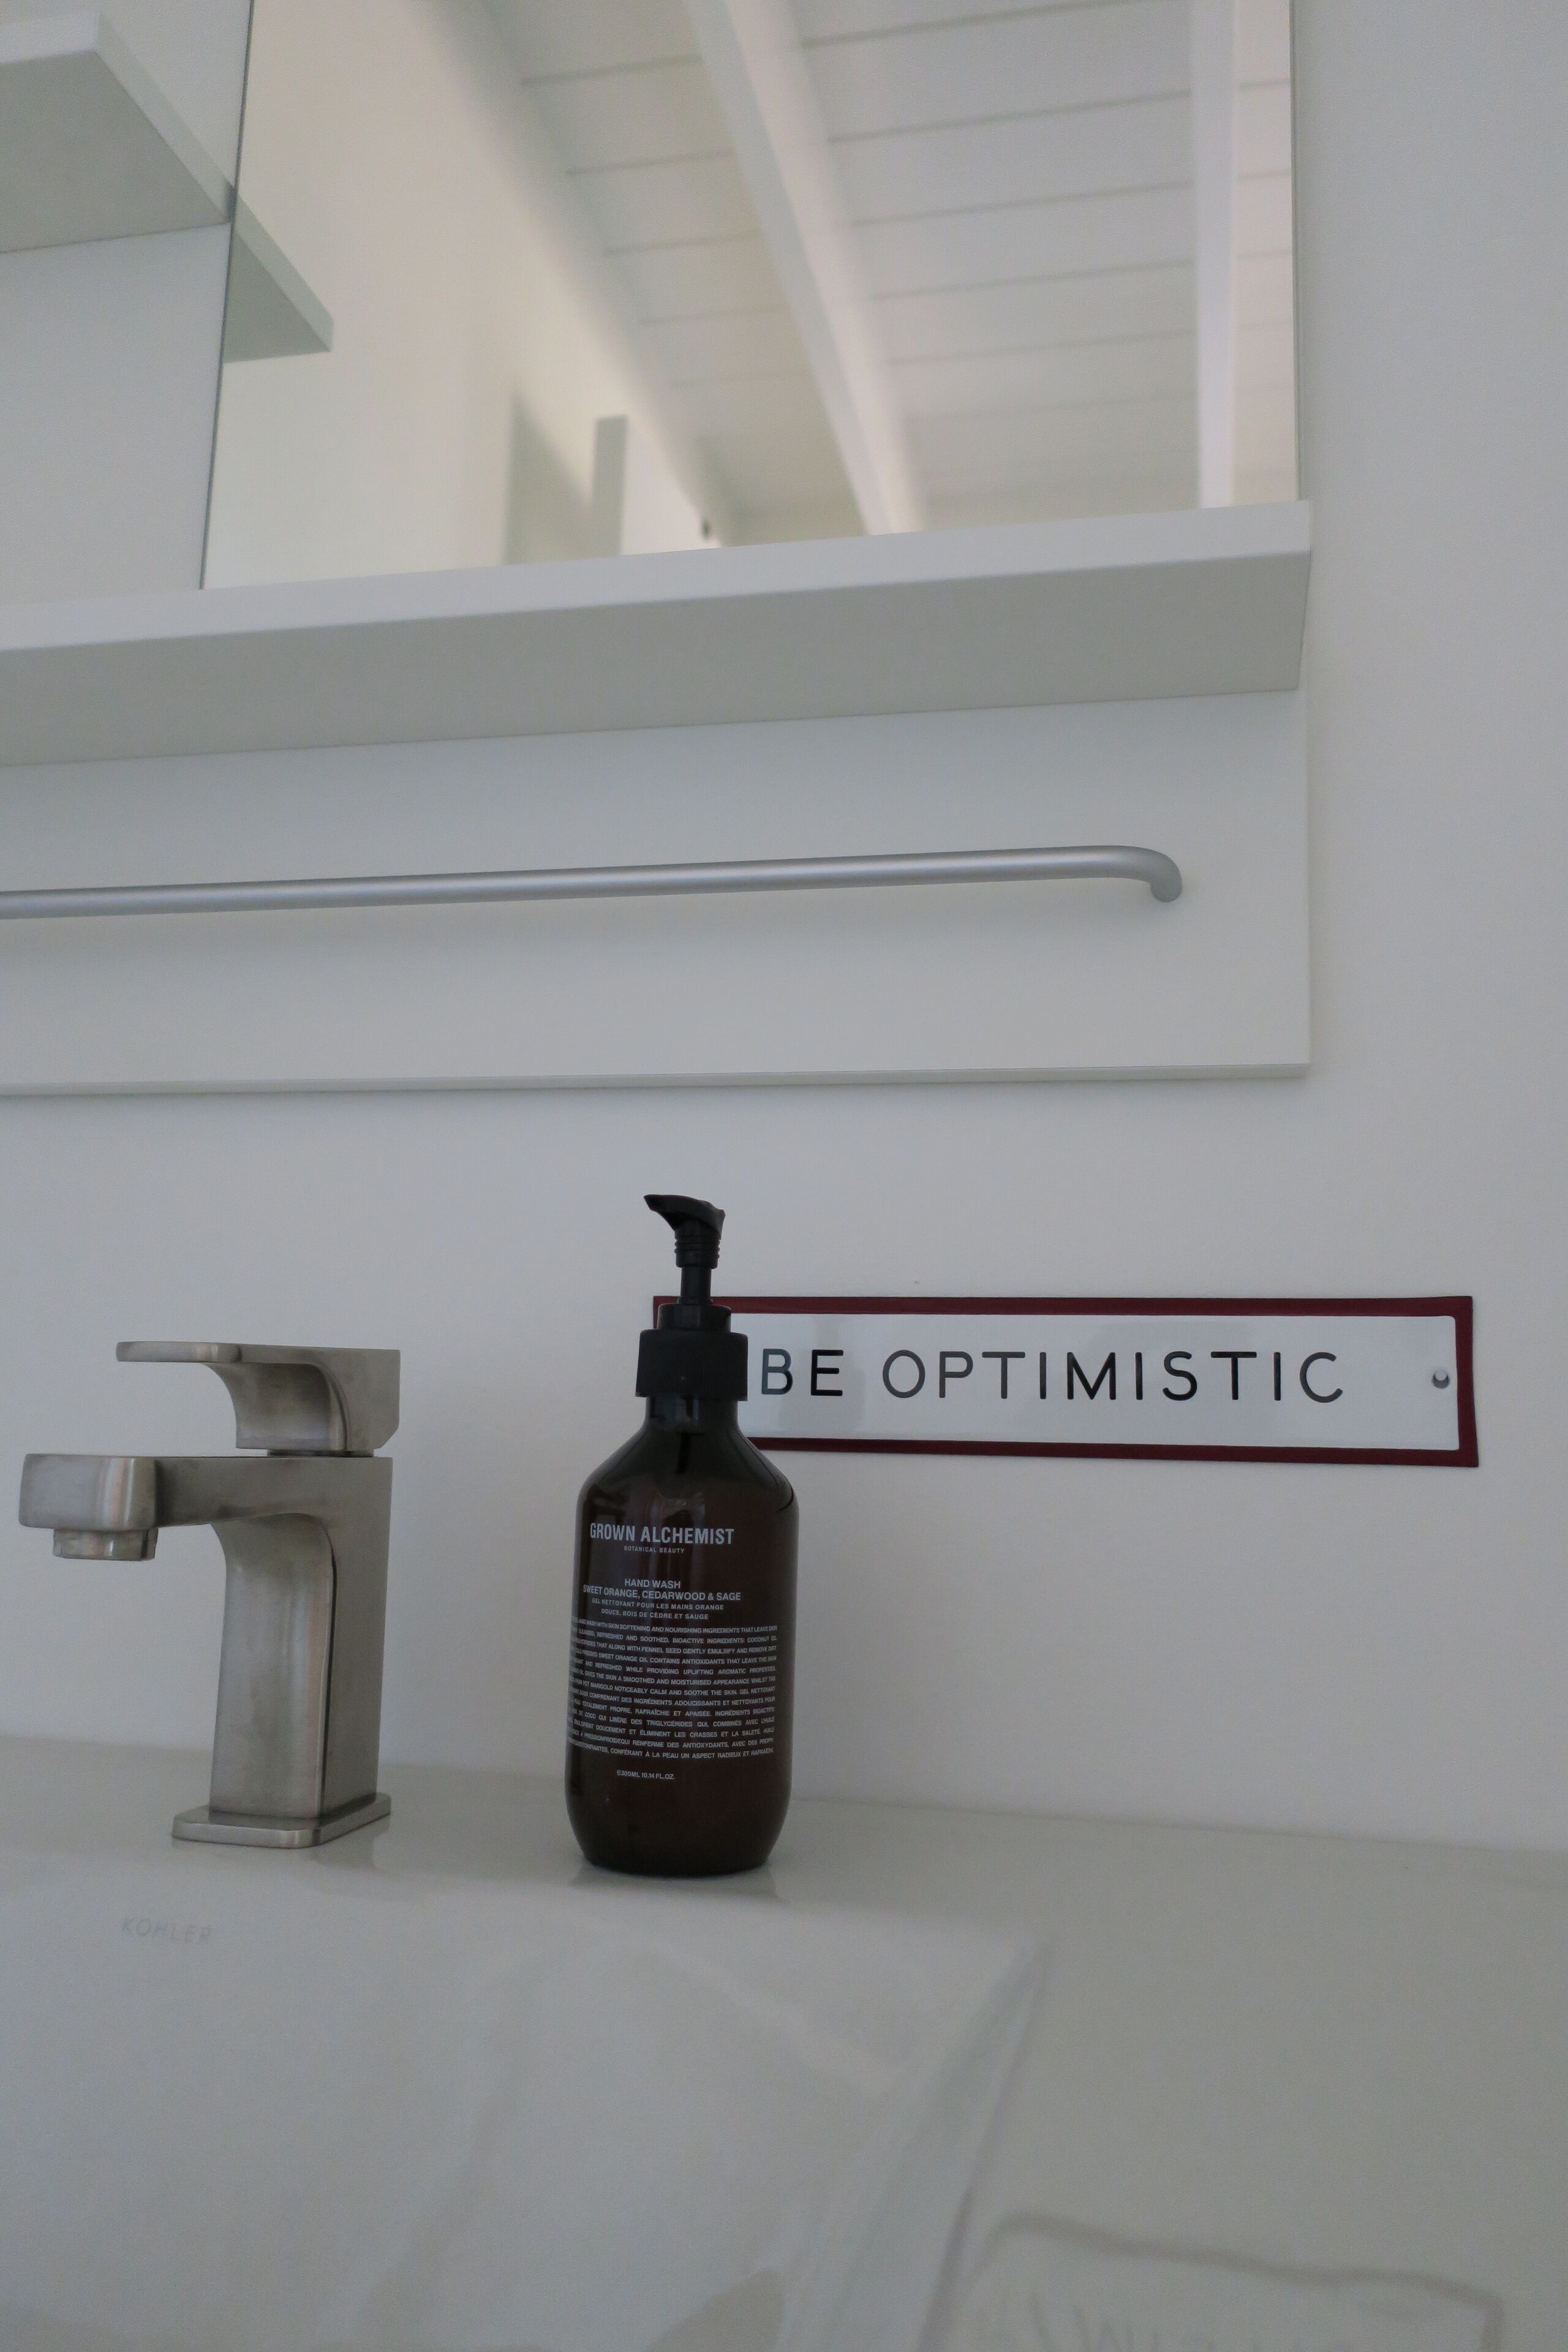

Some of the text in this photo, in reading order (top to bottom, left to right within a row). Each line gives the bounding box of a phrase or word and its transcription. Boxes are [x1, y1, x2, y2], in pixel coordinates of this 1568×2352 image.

[761, 1348, 1343, 1403] BE OPTIMISTIC
[590, 1523, 734, 1544] GROWN ALCHEMIST
[625, 1578, 680, 1589] HAND WASH
[583, 1585, 603, 1595] SWEET
[604, 1588, 640, 1599] ORANGE,
[642, 1591, 706, 1600] CEDARWOOD
[716, 1592, 741, 1600] SAGE
[595, 1662, 622, 1671] REFRESHED
[596, 1725, 626, 1733] DOUCEMENT
